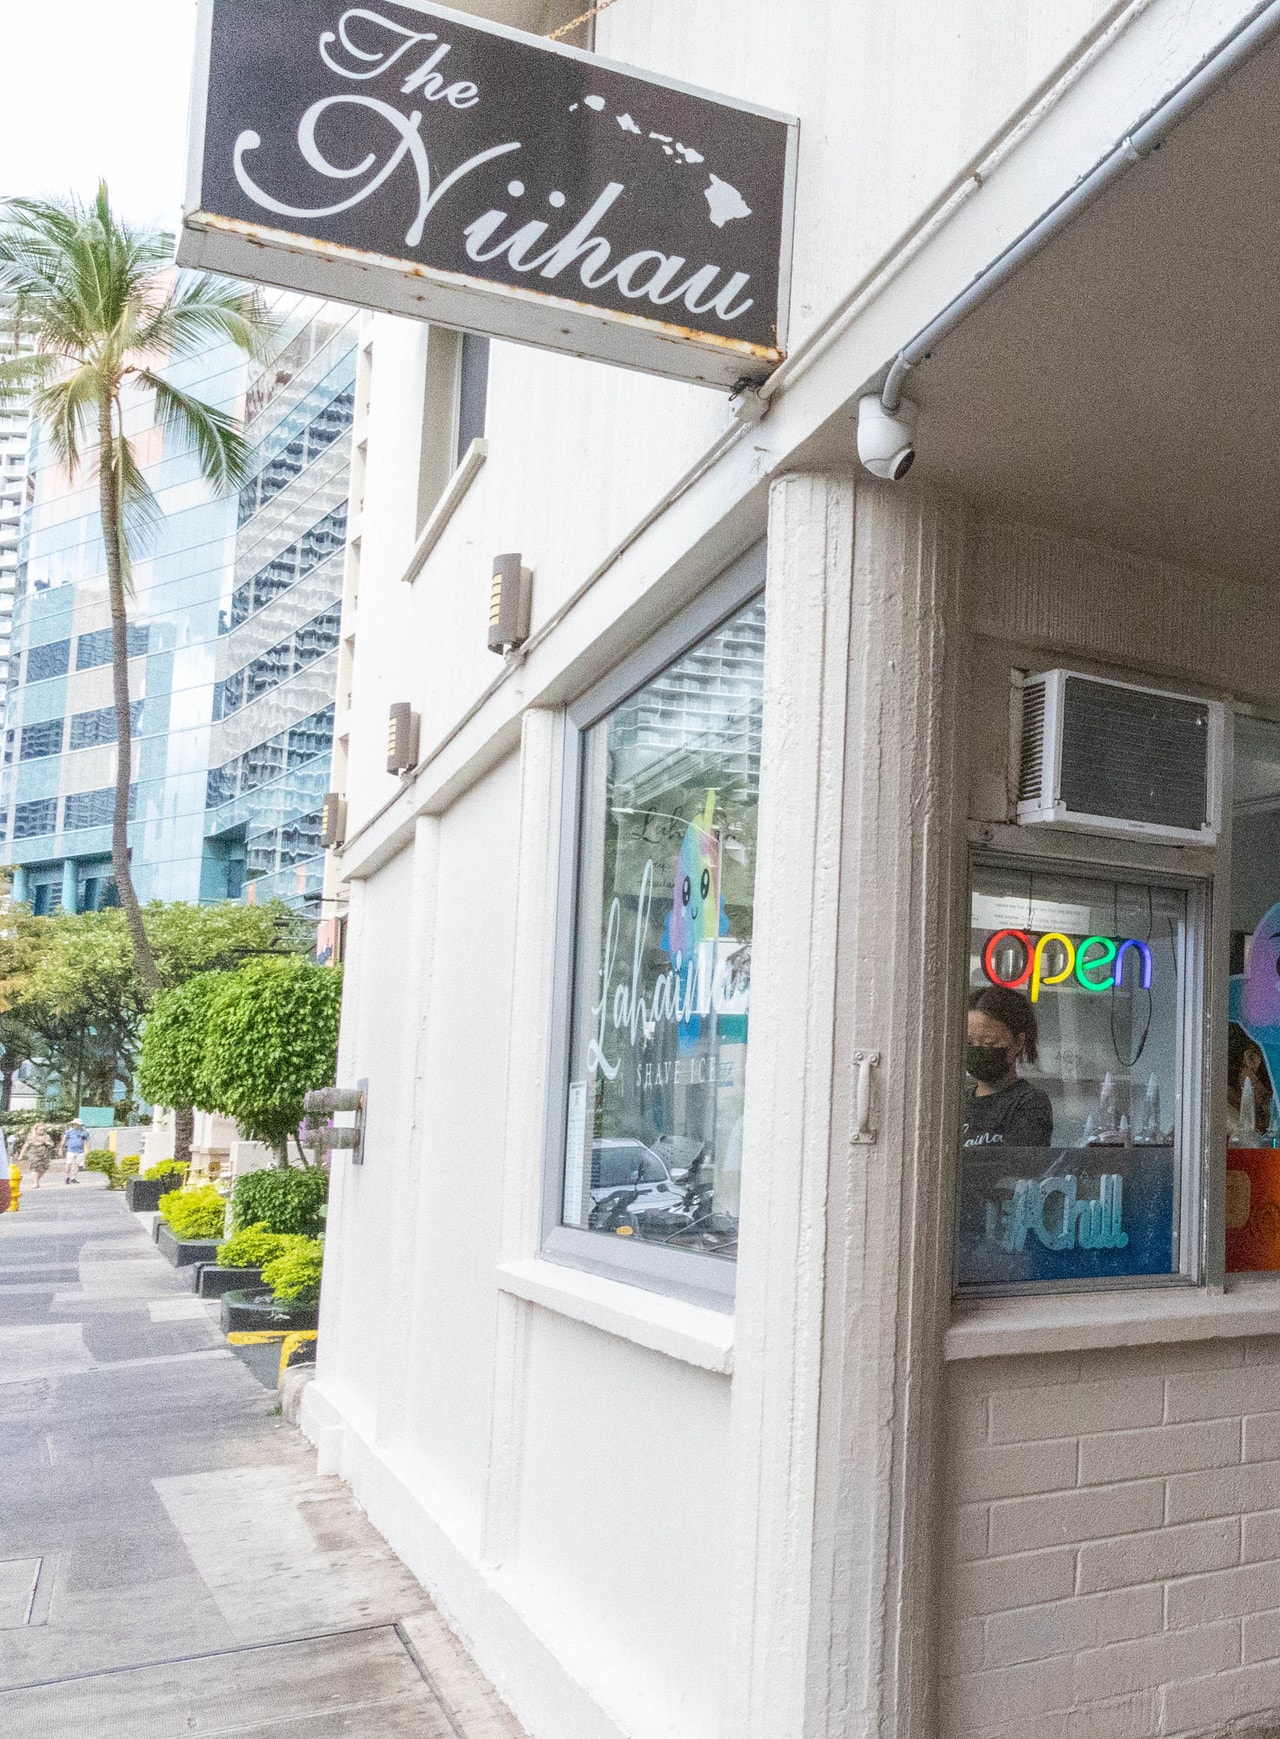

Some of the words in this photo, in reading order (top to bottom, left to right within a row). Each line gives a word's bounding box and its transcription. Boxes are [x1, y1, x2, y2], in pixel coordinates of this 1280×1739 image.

[319, 8, 480, 109] The
[234, 94, 754, 321] Niihau
[637, 1060, 681, 1090] SHAVE
[690, 1057, 716, 1083] ICE
